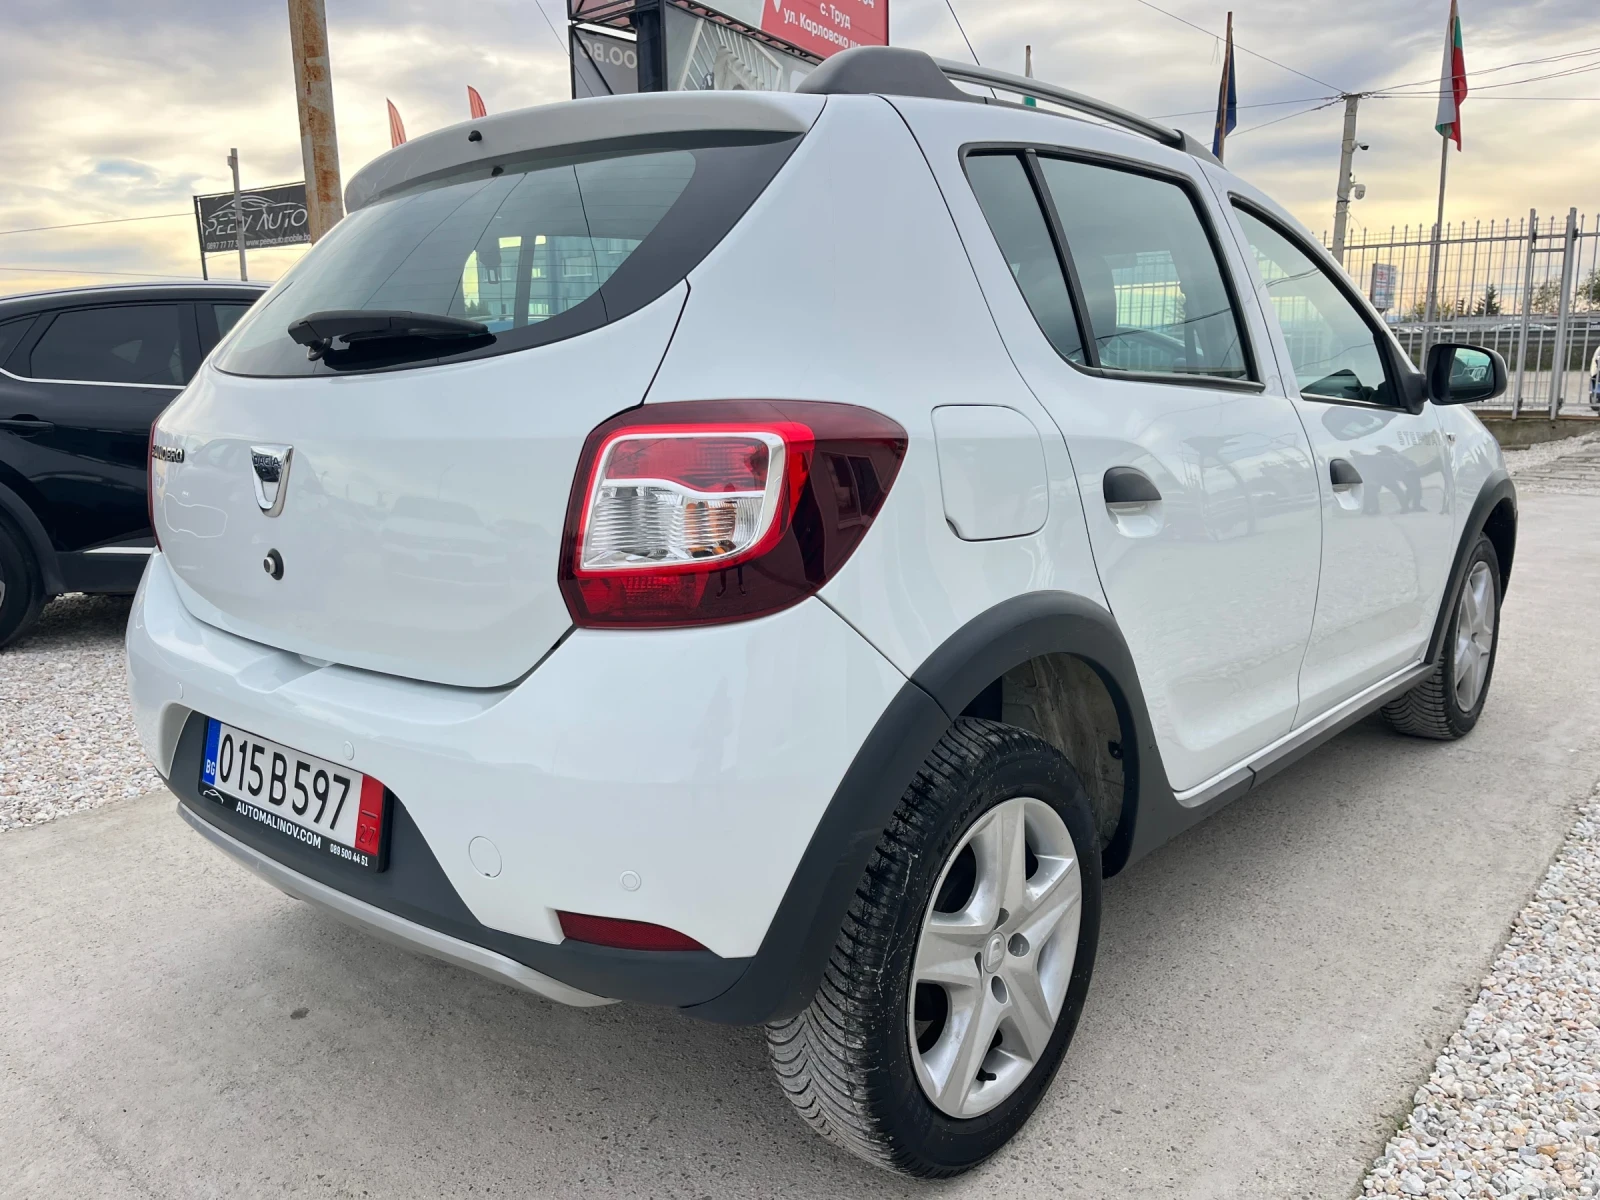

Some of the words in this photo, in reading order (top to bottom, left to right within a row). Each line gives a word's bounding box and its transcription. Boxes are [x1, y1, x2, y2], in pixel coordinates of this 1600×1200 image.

[783, 8, 799, 25] ул.
[799, 12, 849, 49] Карловско
[830, 4, 851, 30] Труд
[256, 208, 308, 231] AUTO
[205, 759, 216, 776] BG
[219, 733, 351, 830] 015B597
[236, 801, 321, 849] AUTOMALINOV.COM
[359, 823, 376, 846] 27
[330, 843, 341, 856] 089
[341, 847, 352, 860] 500
[353, 852, 360, 864] 44
[361, 855, 369, 867] 51
